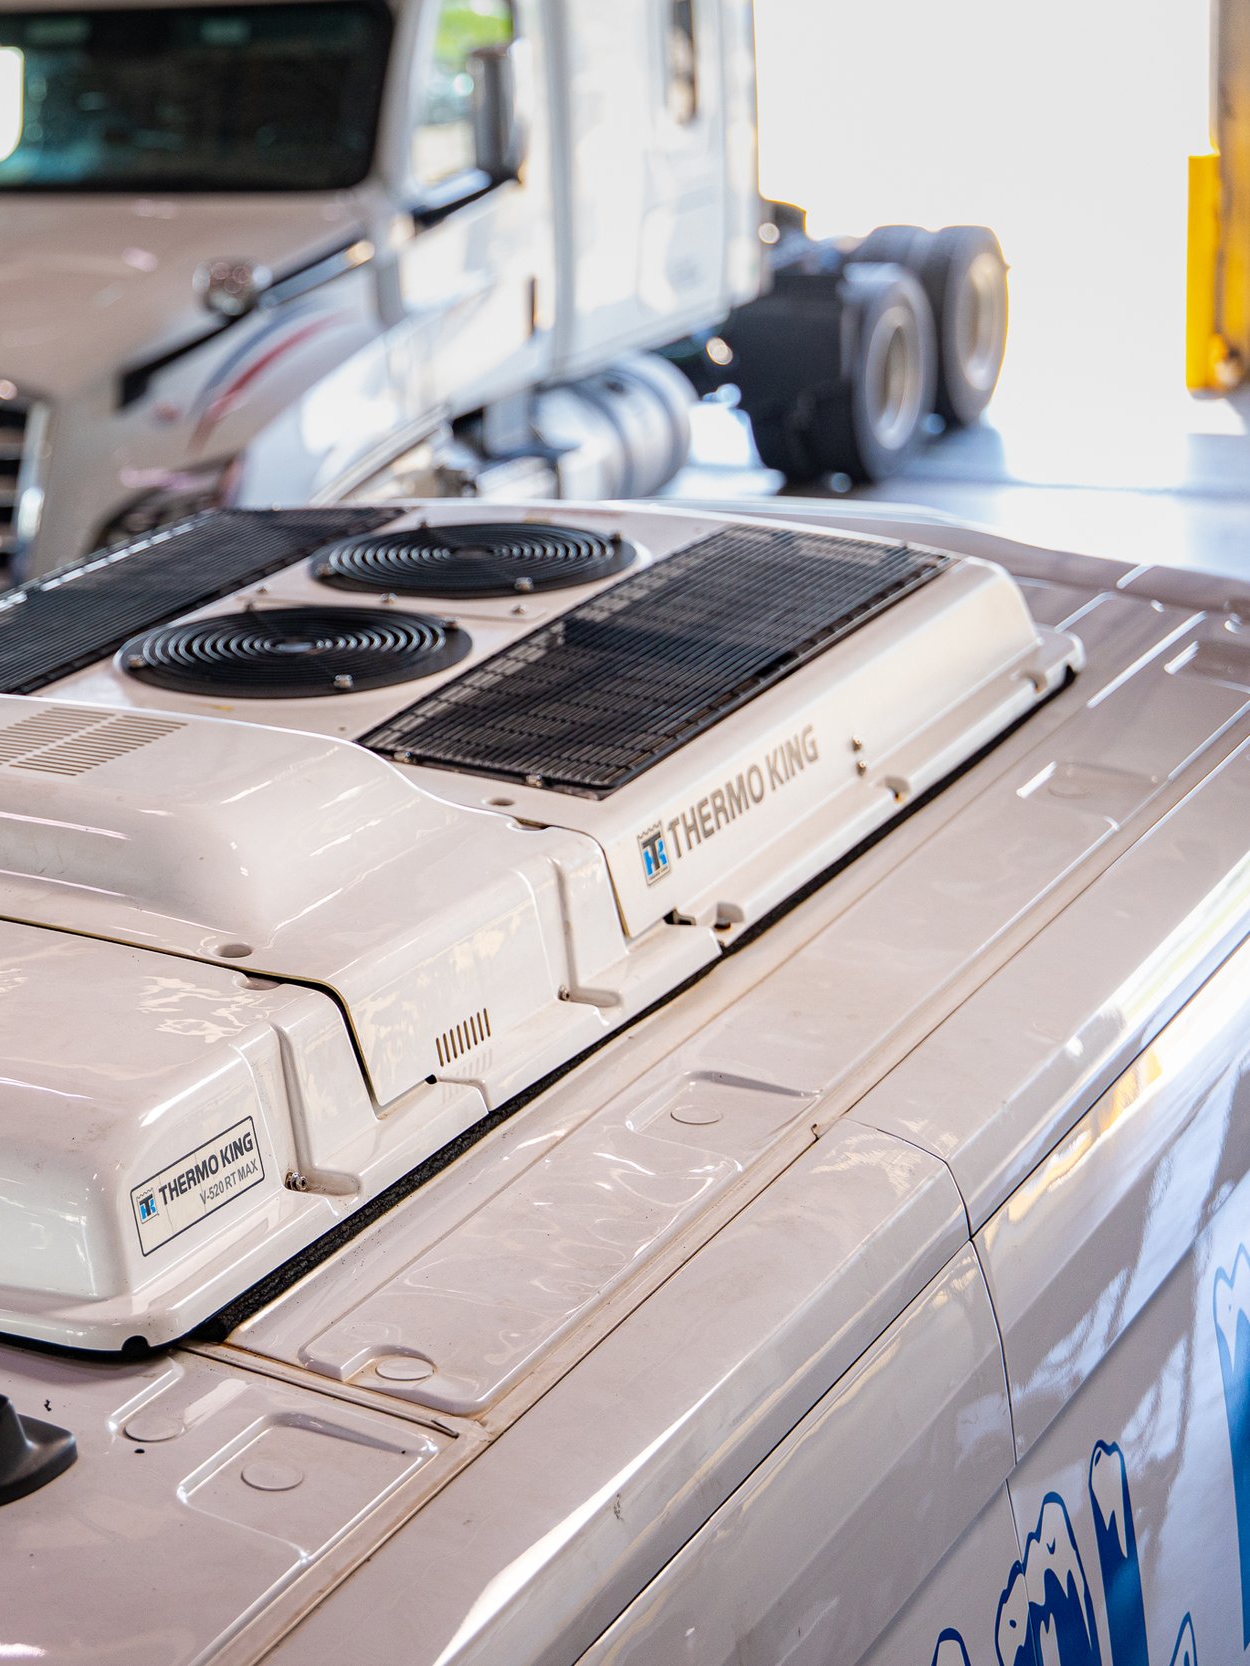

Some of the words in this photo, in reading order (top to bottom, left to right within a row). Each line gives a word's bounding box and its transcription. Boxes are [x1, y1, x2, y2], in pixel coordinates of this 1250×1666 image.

[667, 764, 765, 859] THERMO
[765, 724, 819, 792] KING
[158, 1154, 220, 1206] THERMO
[221, 1132, 254, 1168] KING
[199, 1182, 225, 1205] V-520
[225, 1171, 238, 1191] RT
[238, 1158, 259, 1182] MAX
